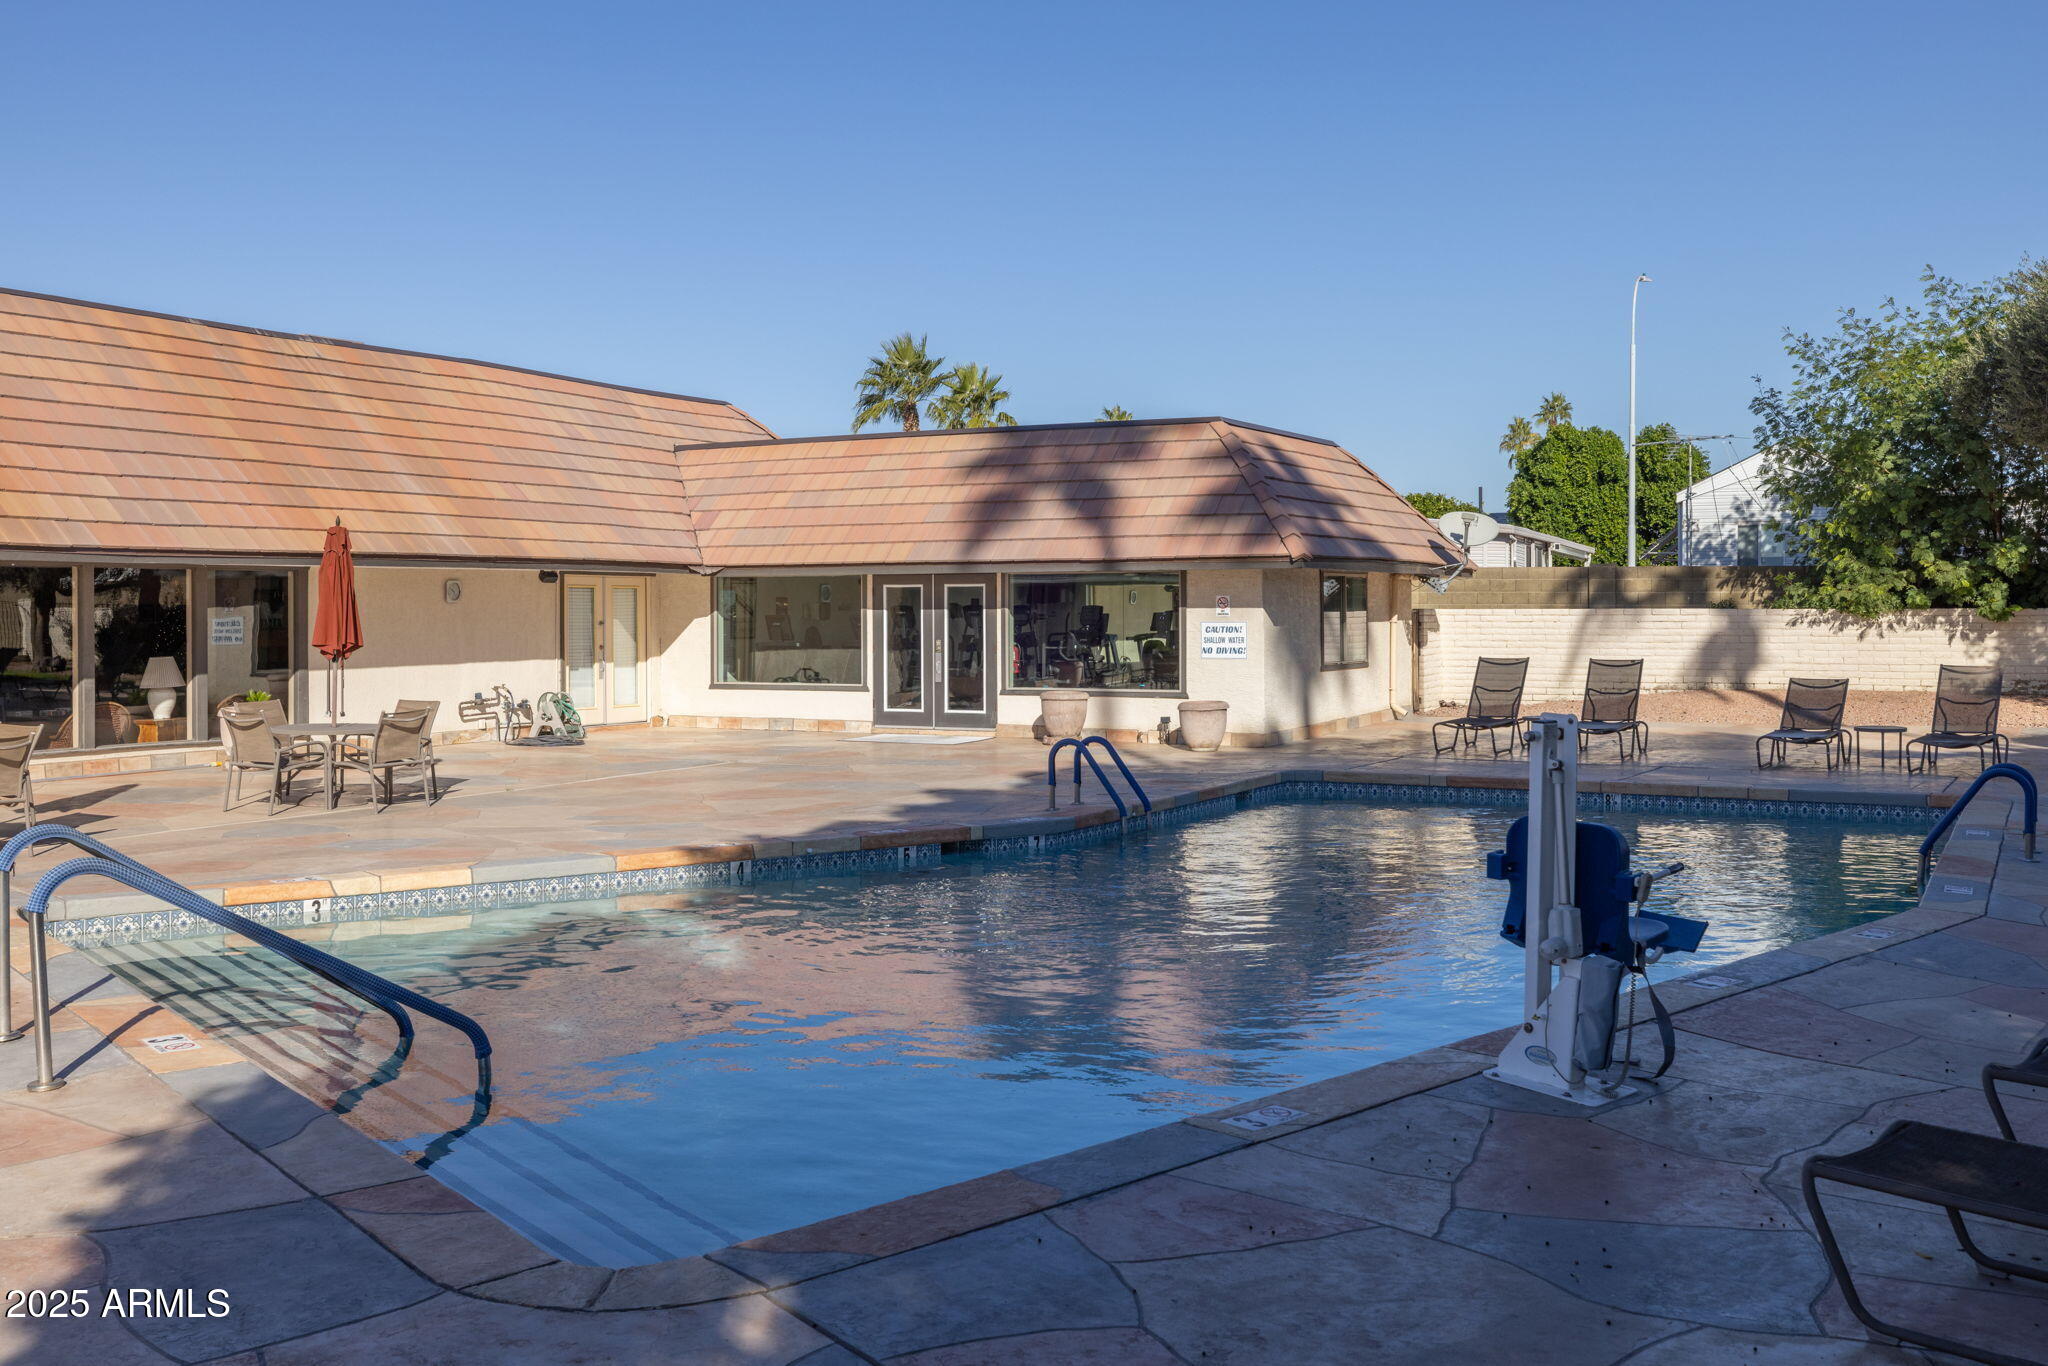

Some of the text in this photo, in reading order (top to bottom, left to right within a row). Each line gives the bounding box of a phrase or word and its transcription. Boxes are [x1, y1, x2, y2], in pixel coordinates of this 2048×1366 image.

[1205, 625, 1243, 634] CAUTION!
[1203, 636, 1245, 644] SHALLOW WATER
[1202, 646, 1246, 654] NO DIVING!
[311, 899, 321, 913] 3
